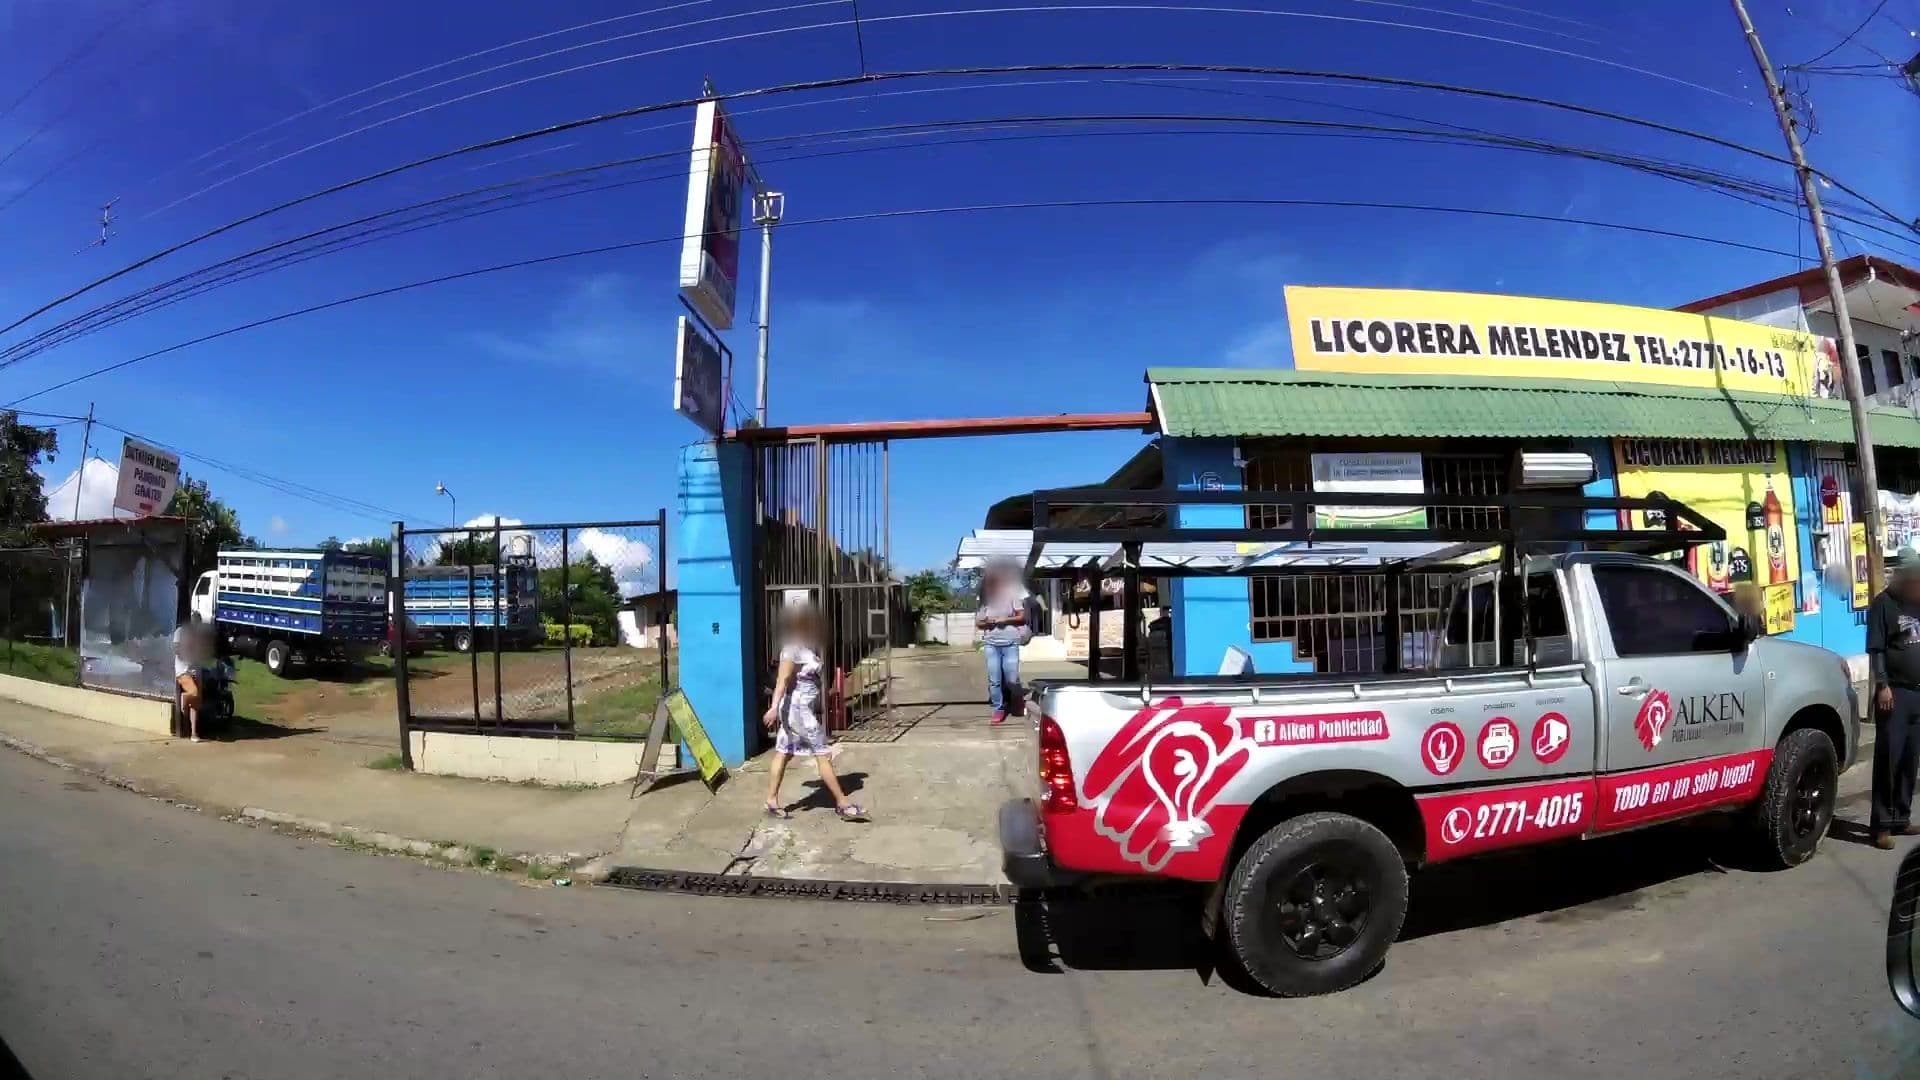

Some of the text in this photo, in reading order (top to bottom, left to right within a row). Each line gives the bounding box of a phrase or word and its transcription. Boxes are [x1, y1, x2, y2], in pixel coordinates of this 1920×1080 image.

[1310, 319, 1481, 355] LICORERA
[1487, 325, 1630, 362] MELENDEZ
[1633, 334, 1785, 378] TEL:2771-16-13
[1279, 722, 1315, 741] Alken
[1318, 716, 1383, 739] Publicidad
[1673, 691, 1746, 727] ALKEN
[1613, 759, 1756, 813] TODO en un solo lugar!
[1473, 791, 1584, 839] 2771-4015
